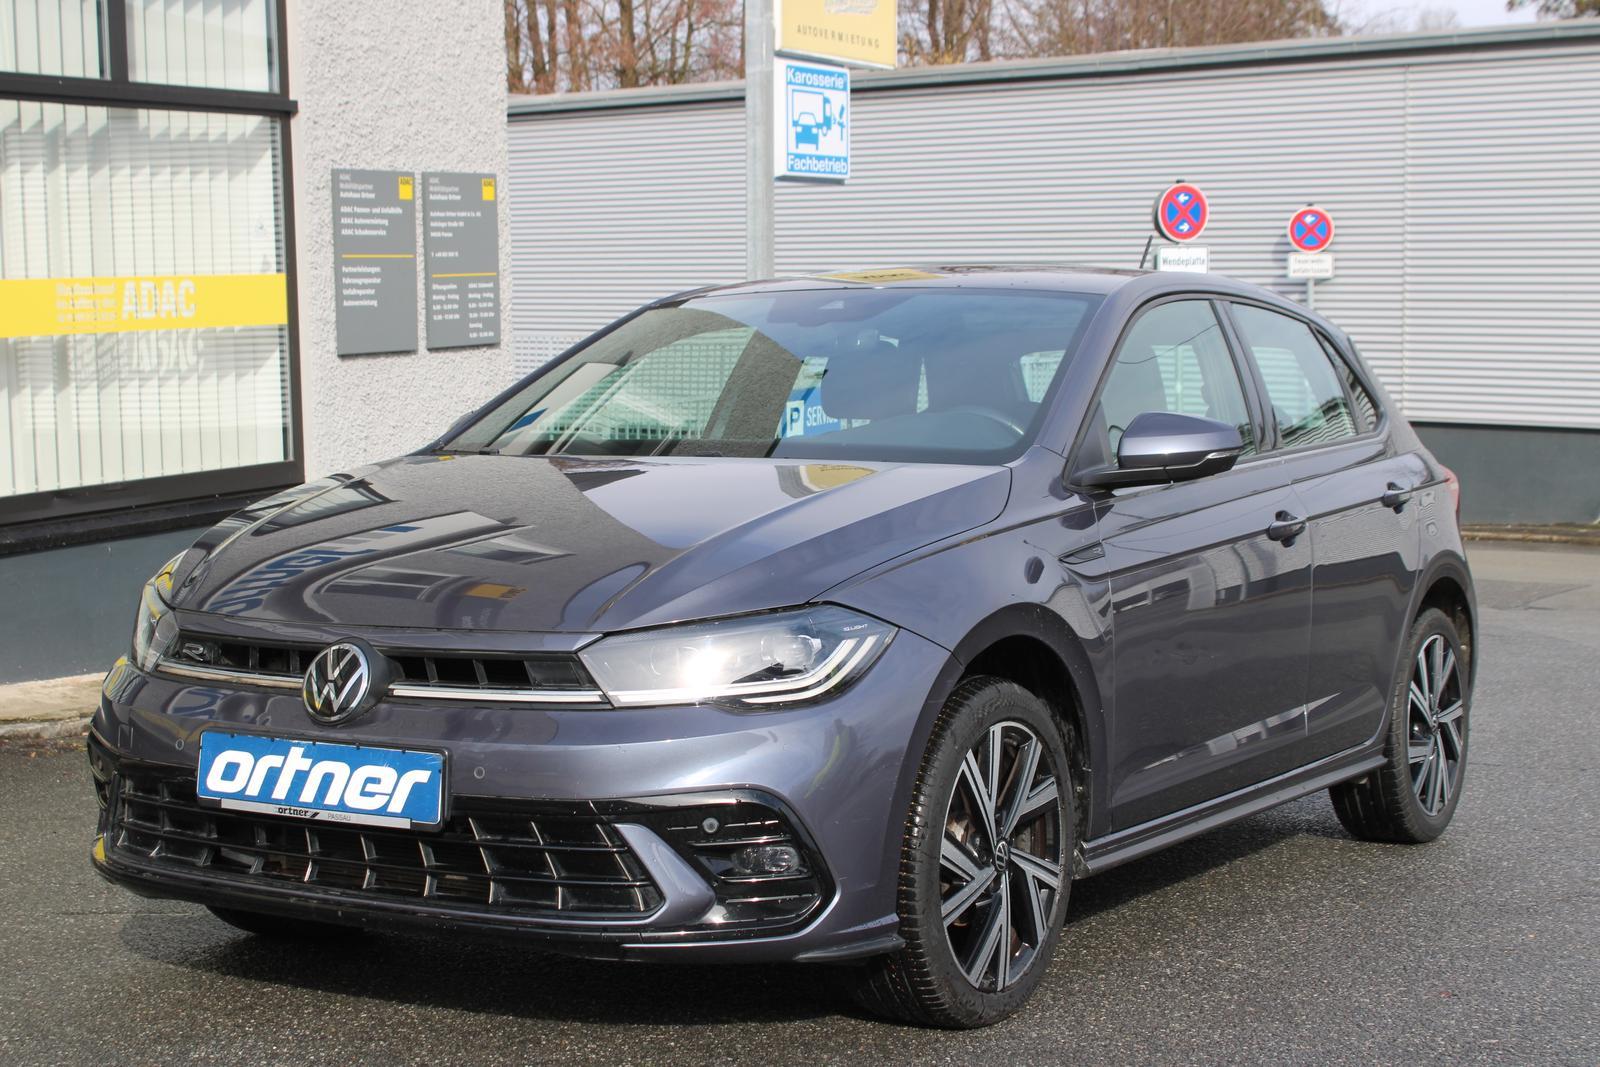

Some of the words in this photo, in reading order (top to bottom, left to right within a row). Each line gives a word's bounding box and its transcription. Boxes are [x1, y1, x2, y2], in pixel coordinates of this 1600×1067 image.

[797, 24, 880, 48] AUTOVERMIETUNG
[787, 155, 848, 174] Fachbetrieb
[122, 279, 197, 320] ADAC
[206, 746, 432, 813] ortner
[278, 806, 309, 818] ortner
[327, 813, 351, 821] PASSAU
